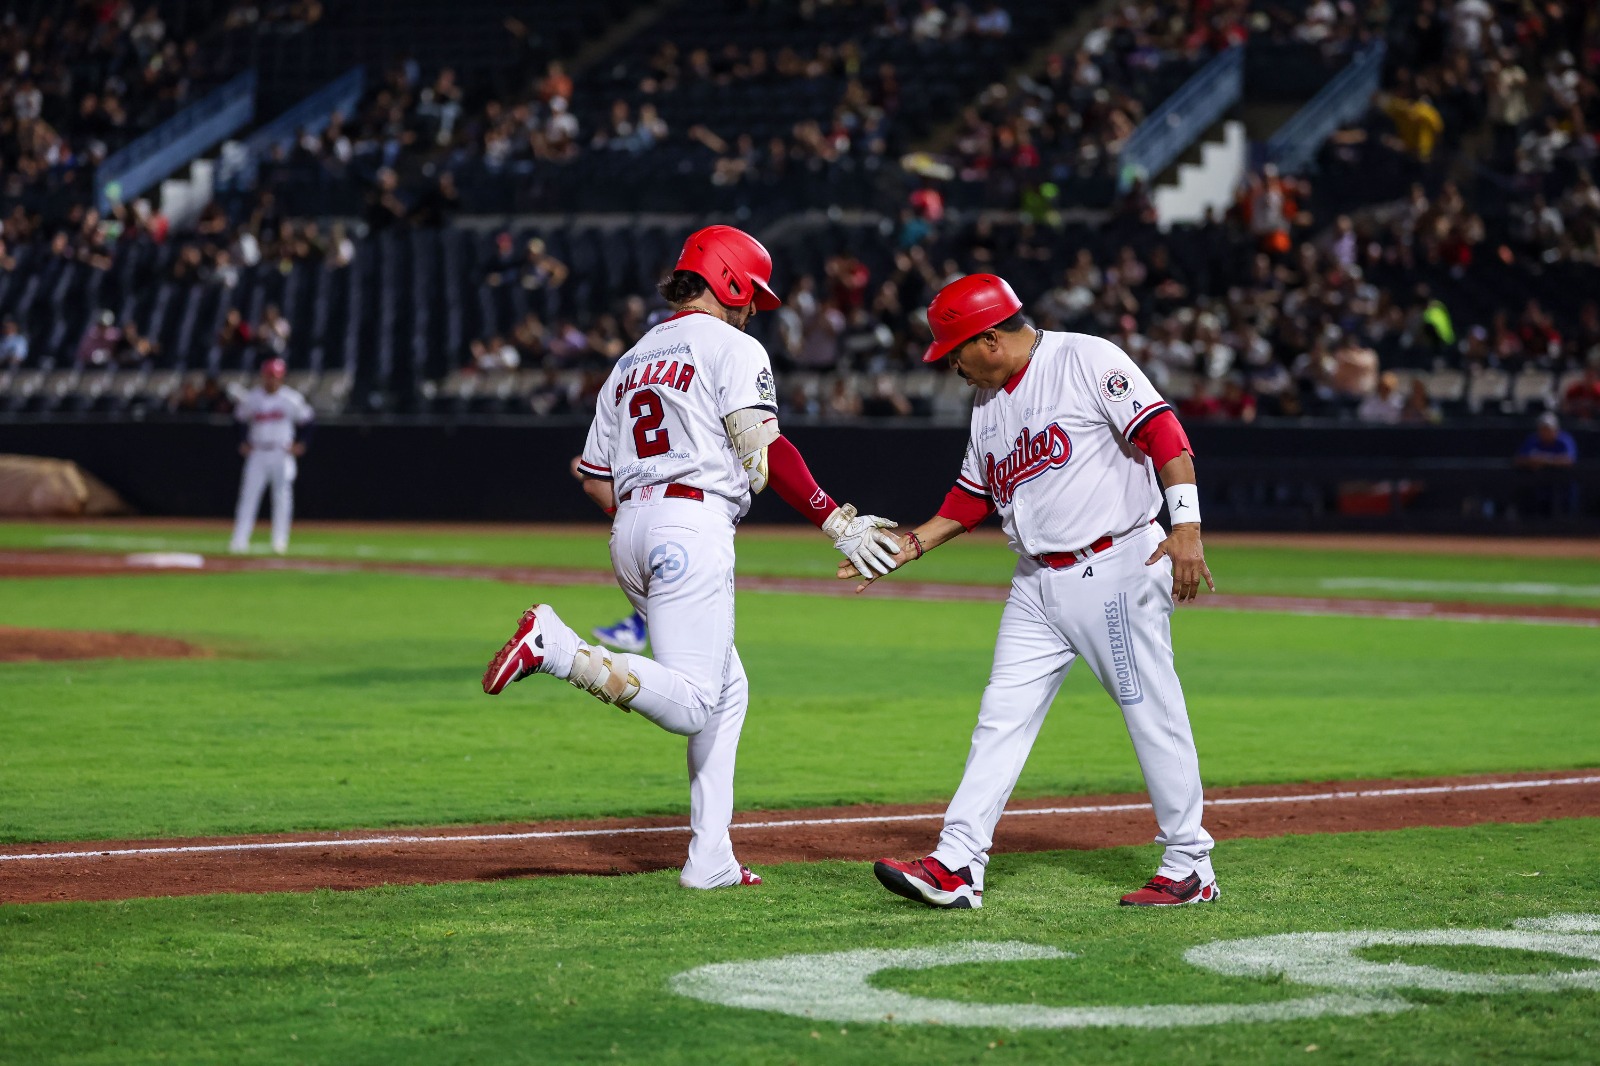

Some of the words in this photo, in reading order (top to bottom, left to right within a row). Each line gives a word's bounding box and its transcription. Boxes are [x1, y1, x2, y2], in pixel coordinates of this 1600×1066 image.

[615, 360, 695, 407] SALAZAR
[633, 343, 691, 365] benavides
[629, 388, 670, 459] 2
[1104, 601, 1132, 693] PAQUETEXPRESS
